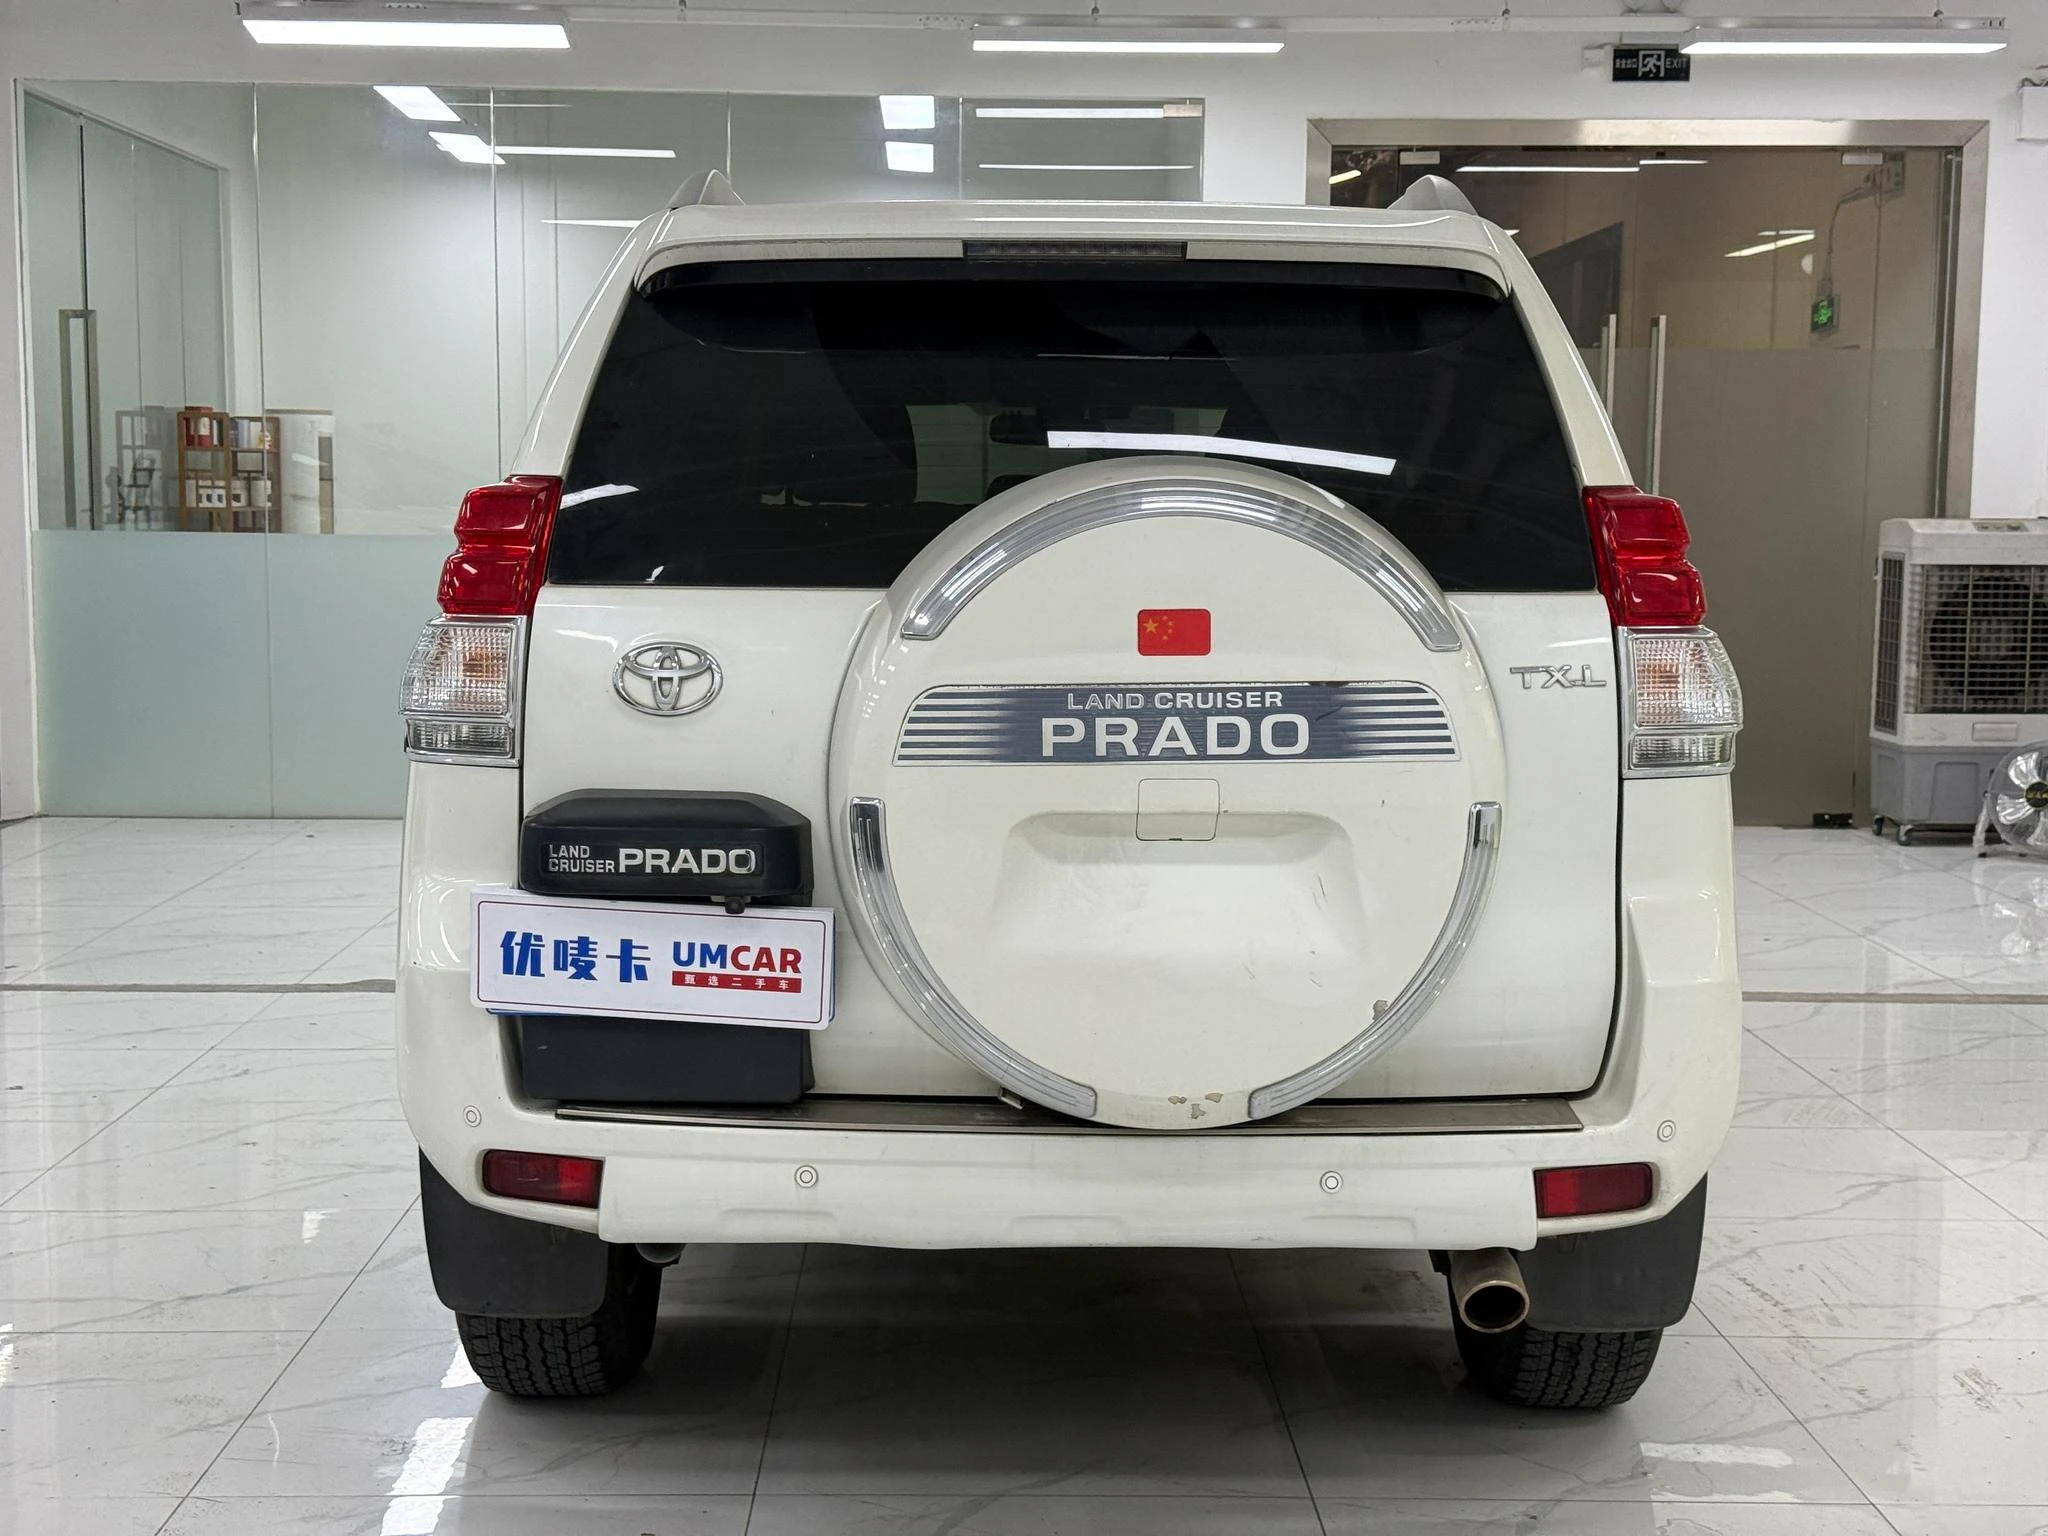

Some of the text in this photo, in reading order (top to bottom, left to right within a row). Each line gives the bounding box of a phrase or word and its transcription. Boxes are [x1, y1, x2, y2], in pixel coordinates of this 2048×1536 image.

[1665, 58, 1687, 69] EXIT
[1067, 691, 1283, 710] LAND CRUISER
[1041, 713, 1310, 758] PRADO
[549, 844, 590, 859] LAND
[618, 848, 756, 874] PRADO
[549, 859, 615, 873] CRUISER
[500, 930, 651, 983] 优唛卡
[672, 940, 802, 974] UMCAR
[684, 974, 789, 990] 甄选二手车
